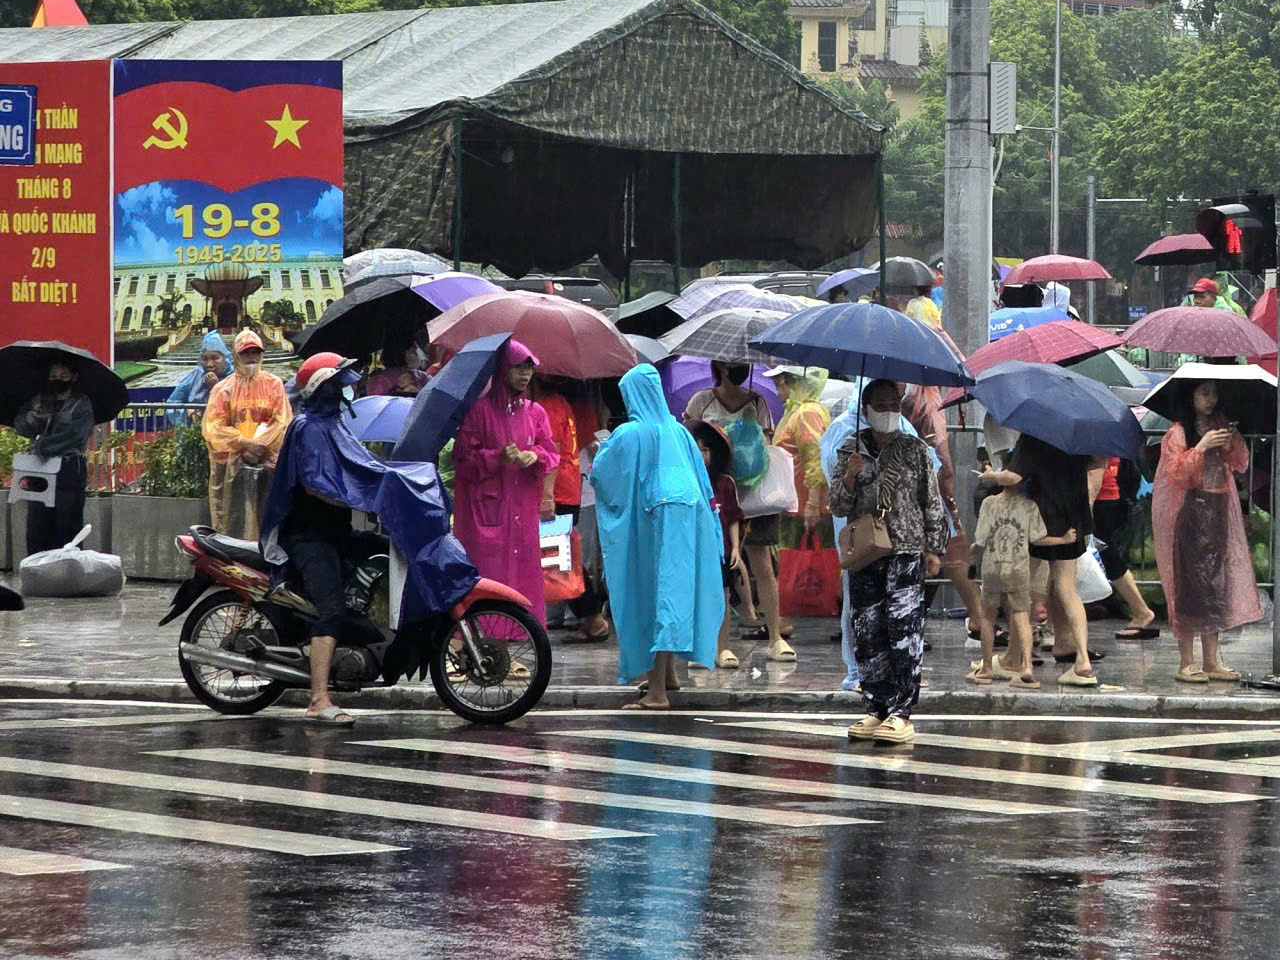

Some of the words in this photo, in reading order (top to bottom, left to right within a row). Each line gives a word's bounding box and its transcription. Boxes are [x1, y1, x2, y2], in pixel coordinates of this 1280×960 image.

[44, 102, 78, 129] THẦN
[44, 142, 83, 167] MẠNG
[16, 174, 59, 199] THÁNG
[63, 177, 72, 200] 8
[13, 206, 49, 235] QUỐC
[52, 209, 97, 234] KHÁNH
[174, 202, 281, 238] 19-8
[31, 246, 56, 268] 2/9
[174, 243, 282, 265] 1945-2025
[11, 274, 37, 303] BẤT
[40, 279, 68, 307] DIỆT
